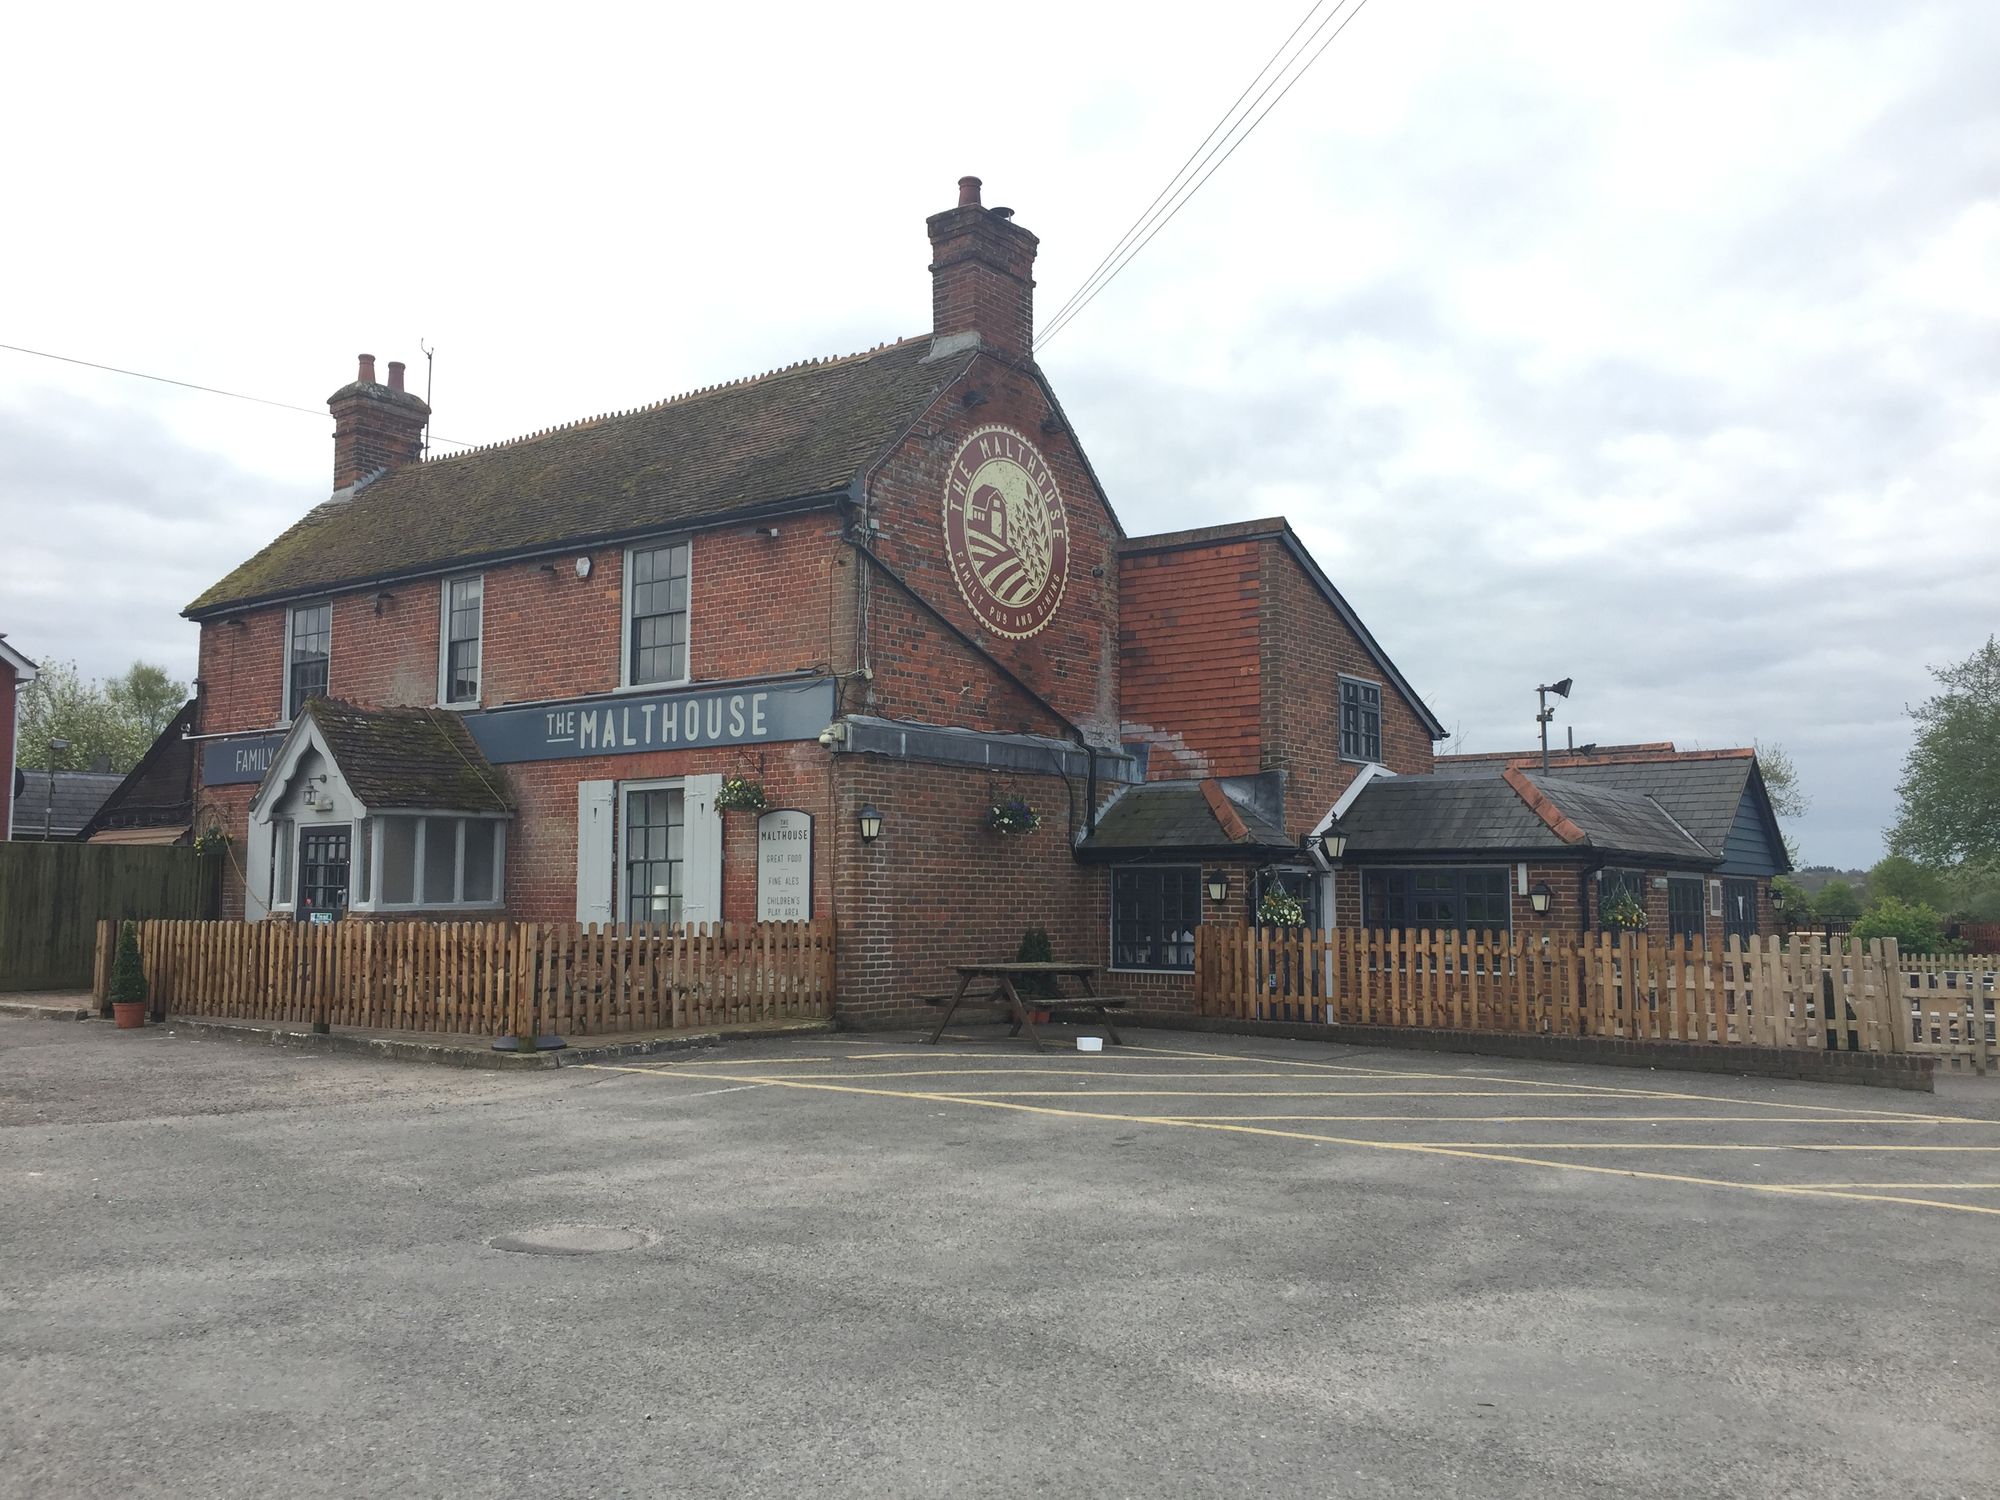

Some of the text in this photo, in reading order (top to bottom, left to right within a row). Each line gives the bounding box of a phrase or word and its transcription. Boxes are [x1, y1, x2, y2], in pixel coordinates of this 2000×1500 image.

[950, 436, 1064, 538] THE MALTHOUSE
[956, 551, 1060, 627] FAMILY PUB AND DINING
[547, 693, 768, 749] THE MALTHOUSE
[235, 747, 274, 773] FAMILY
[761, 829, 808, 841] MALTHOUSE
[766, 854, 802, 863] GREAT FOOD
[768, 876, 800, 885] FINE ALES
[767, 908, 799, 916] PLAY AREA
